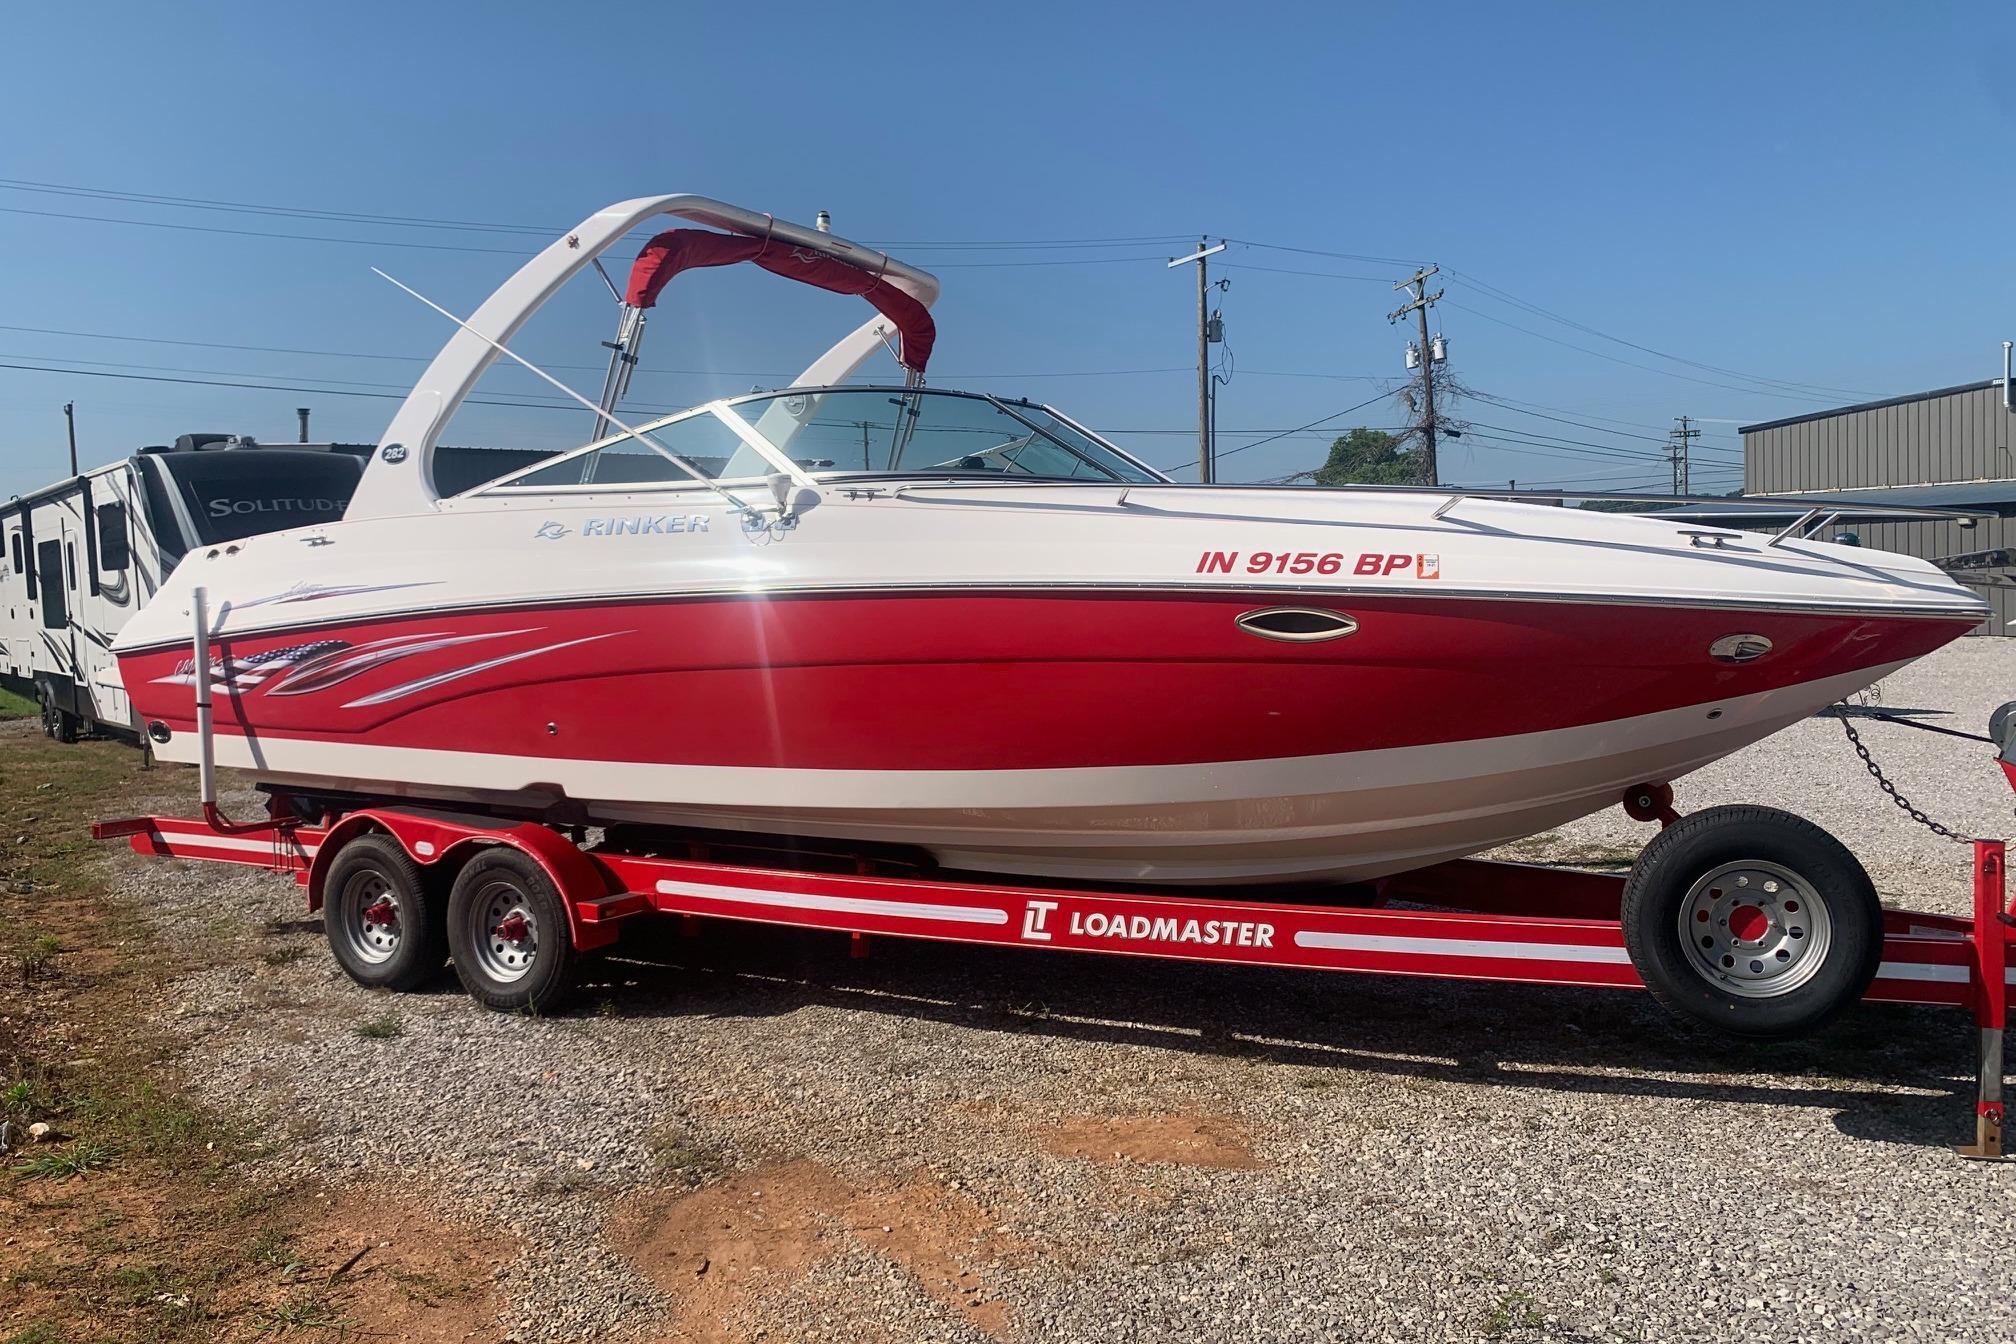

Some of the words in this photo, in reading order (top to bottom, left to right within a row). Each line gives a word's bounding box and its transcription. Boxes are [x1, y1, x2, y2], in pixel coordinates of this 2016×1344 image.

[384, 447, 405, 460] 282
[208, 498, 349, 518] SOLITUDE
[583, 514, 711, 537] RINKER
[1195, 551, 1240, 574] IN
[1246, 552, 1344, 576] 9156
[1353, 553, 1413, 576] BP
[1069, 911, 1276, 948] LOADMASTER
